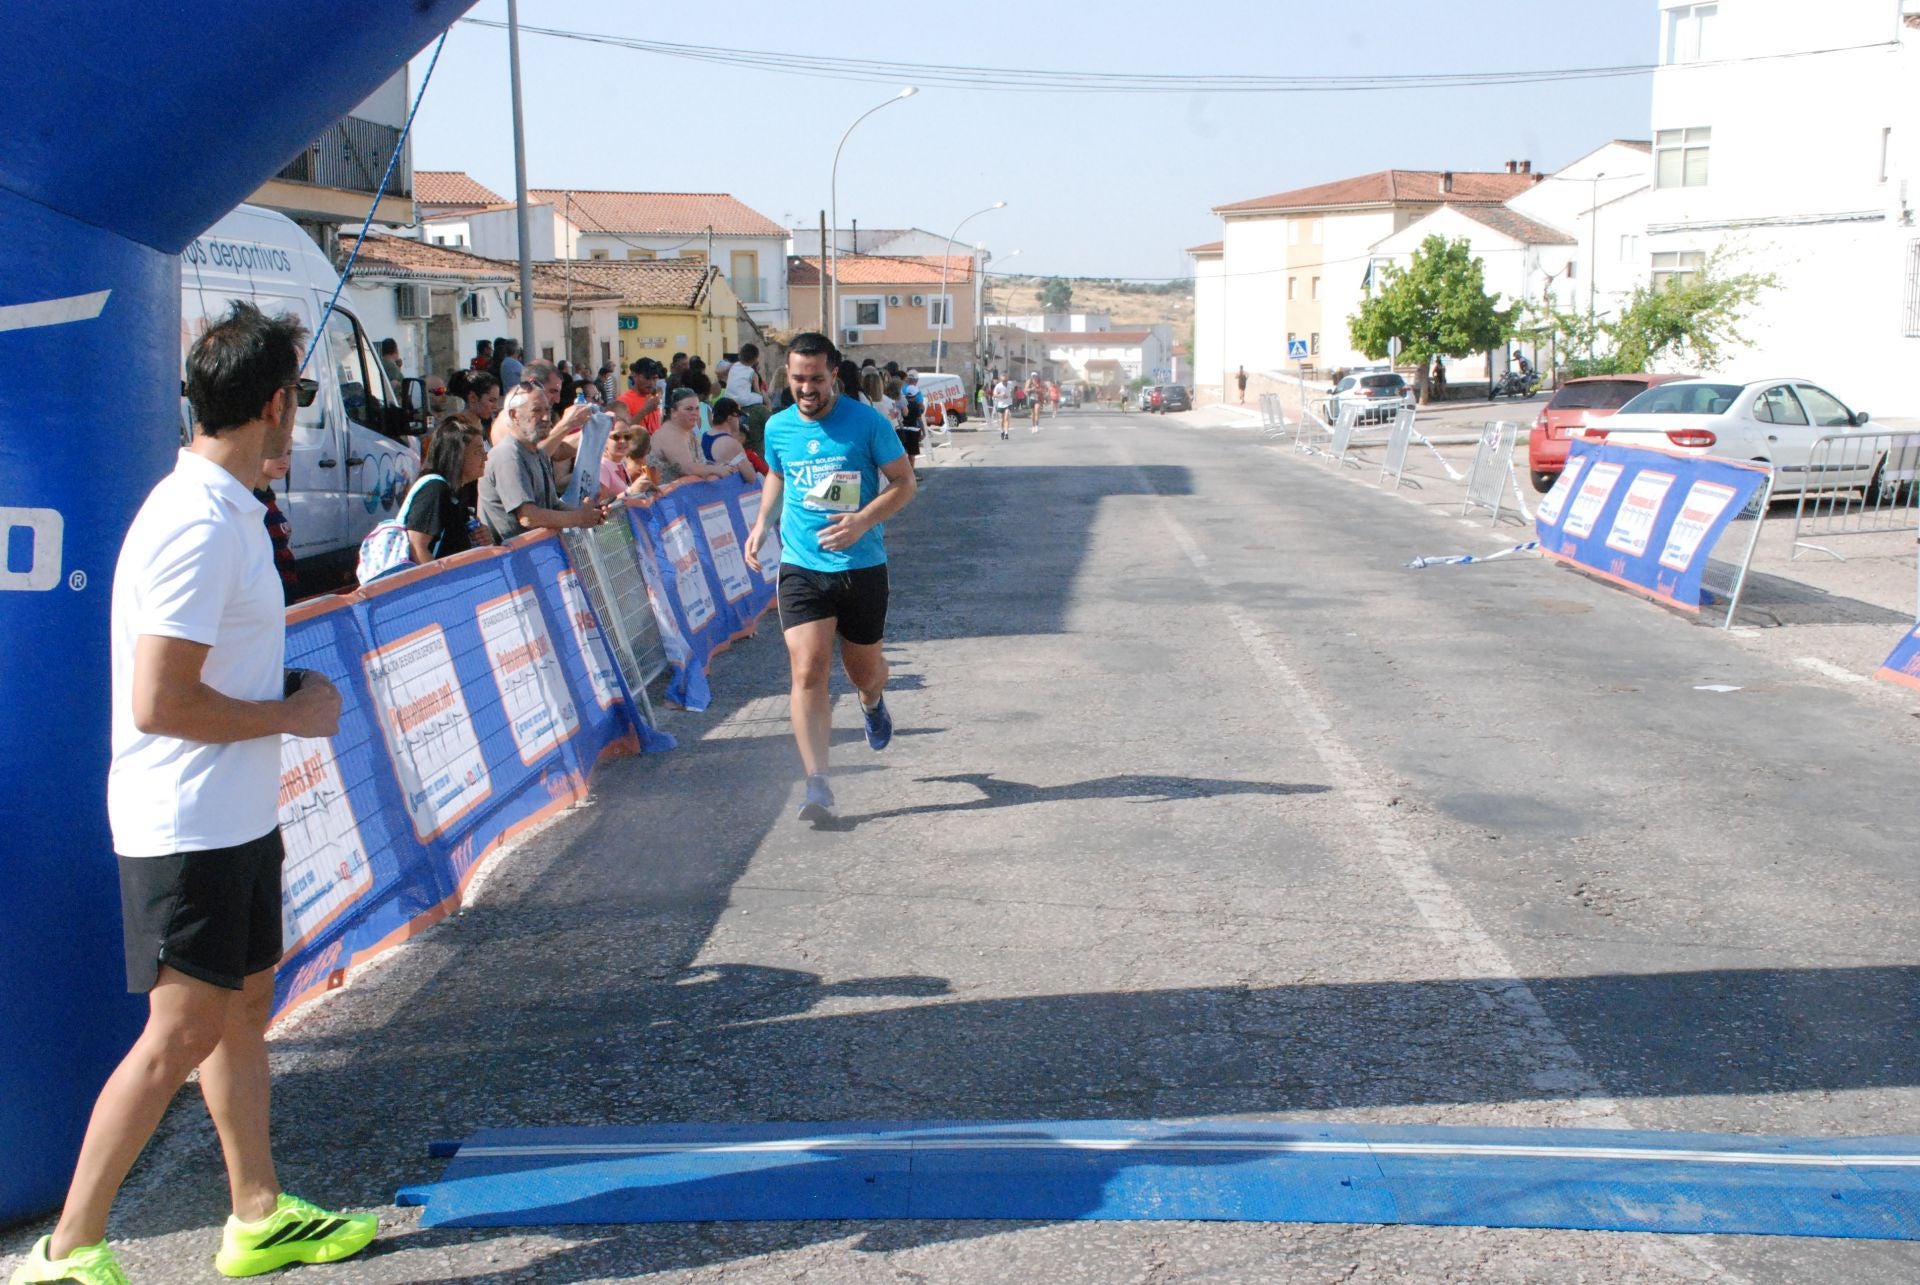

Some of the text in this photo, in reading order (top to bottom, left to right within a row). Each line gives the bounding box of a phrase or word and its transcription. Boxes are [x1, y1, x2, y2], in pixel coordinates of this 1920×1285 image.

[209, 242, 291, 275] deportivos
[815, 456, 847, 464] SOLIDARIA
[789, 466, 812, 486] XI
